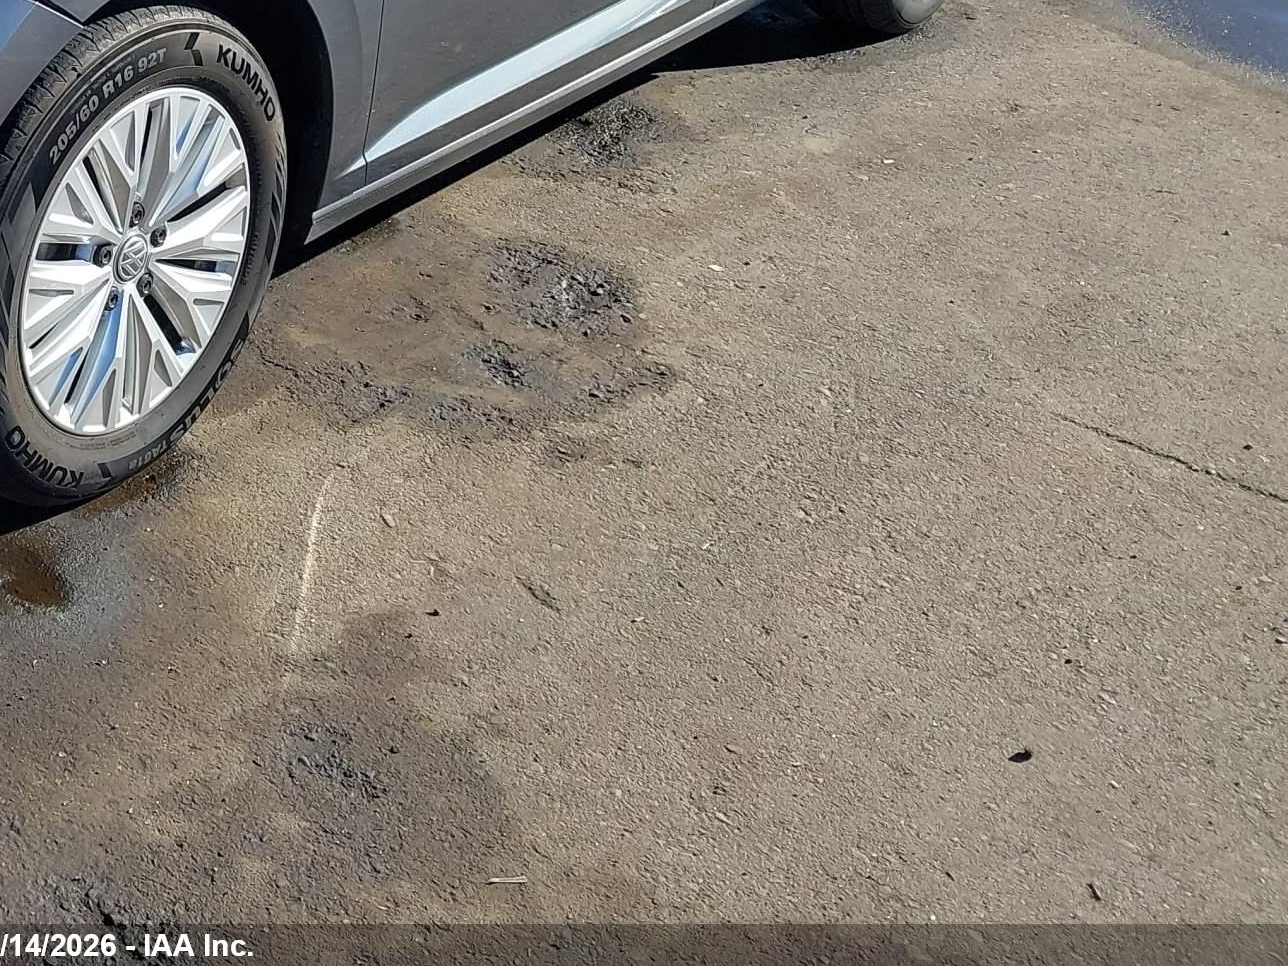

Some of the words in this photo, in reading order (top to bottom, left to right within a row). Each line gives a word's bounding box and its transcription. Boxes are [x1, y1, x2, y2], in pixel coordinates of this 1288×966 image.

[49, 96, 99, 165] 205/60
[102, 65, 134, 100] R16
[138, 47, 167, 73] 92T
[217, 44, 277, 121] KUMHO
[4, 425, 85, 490] KUMHO
